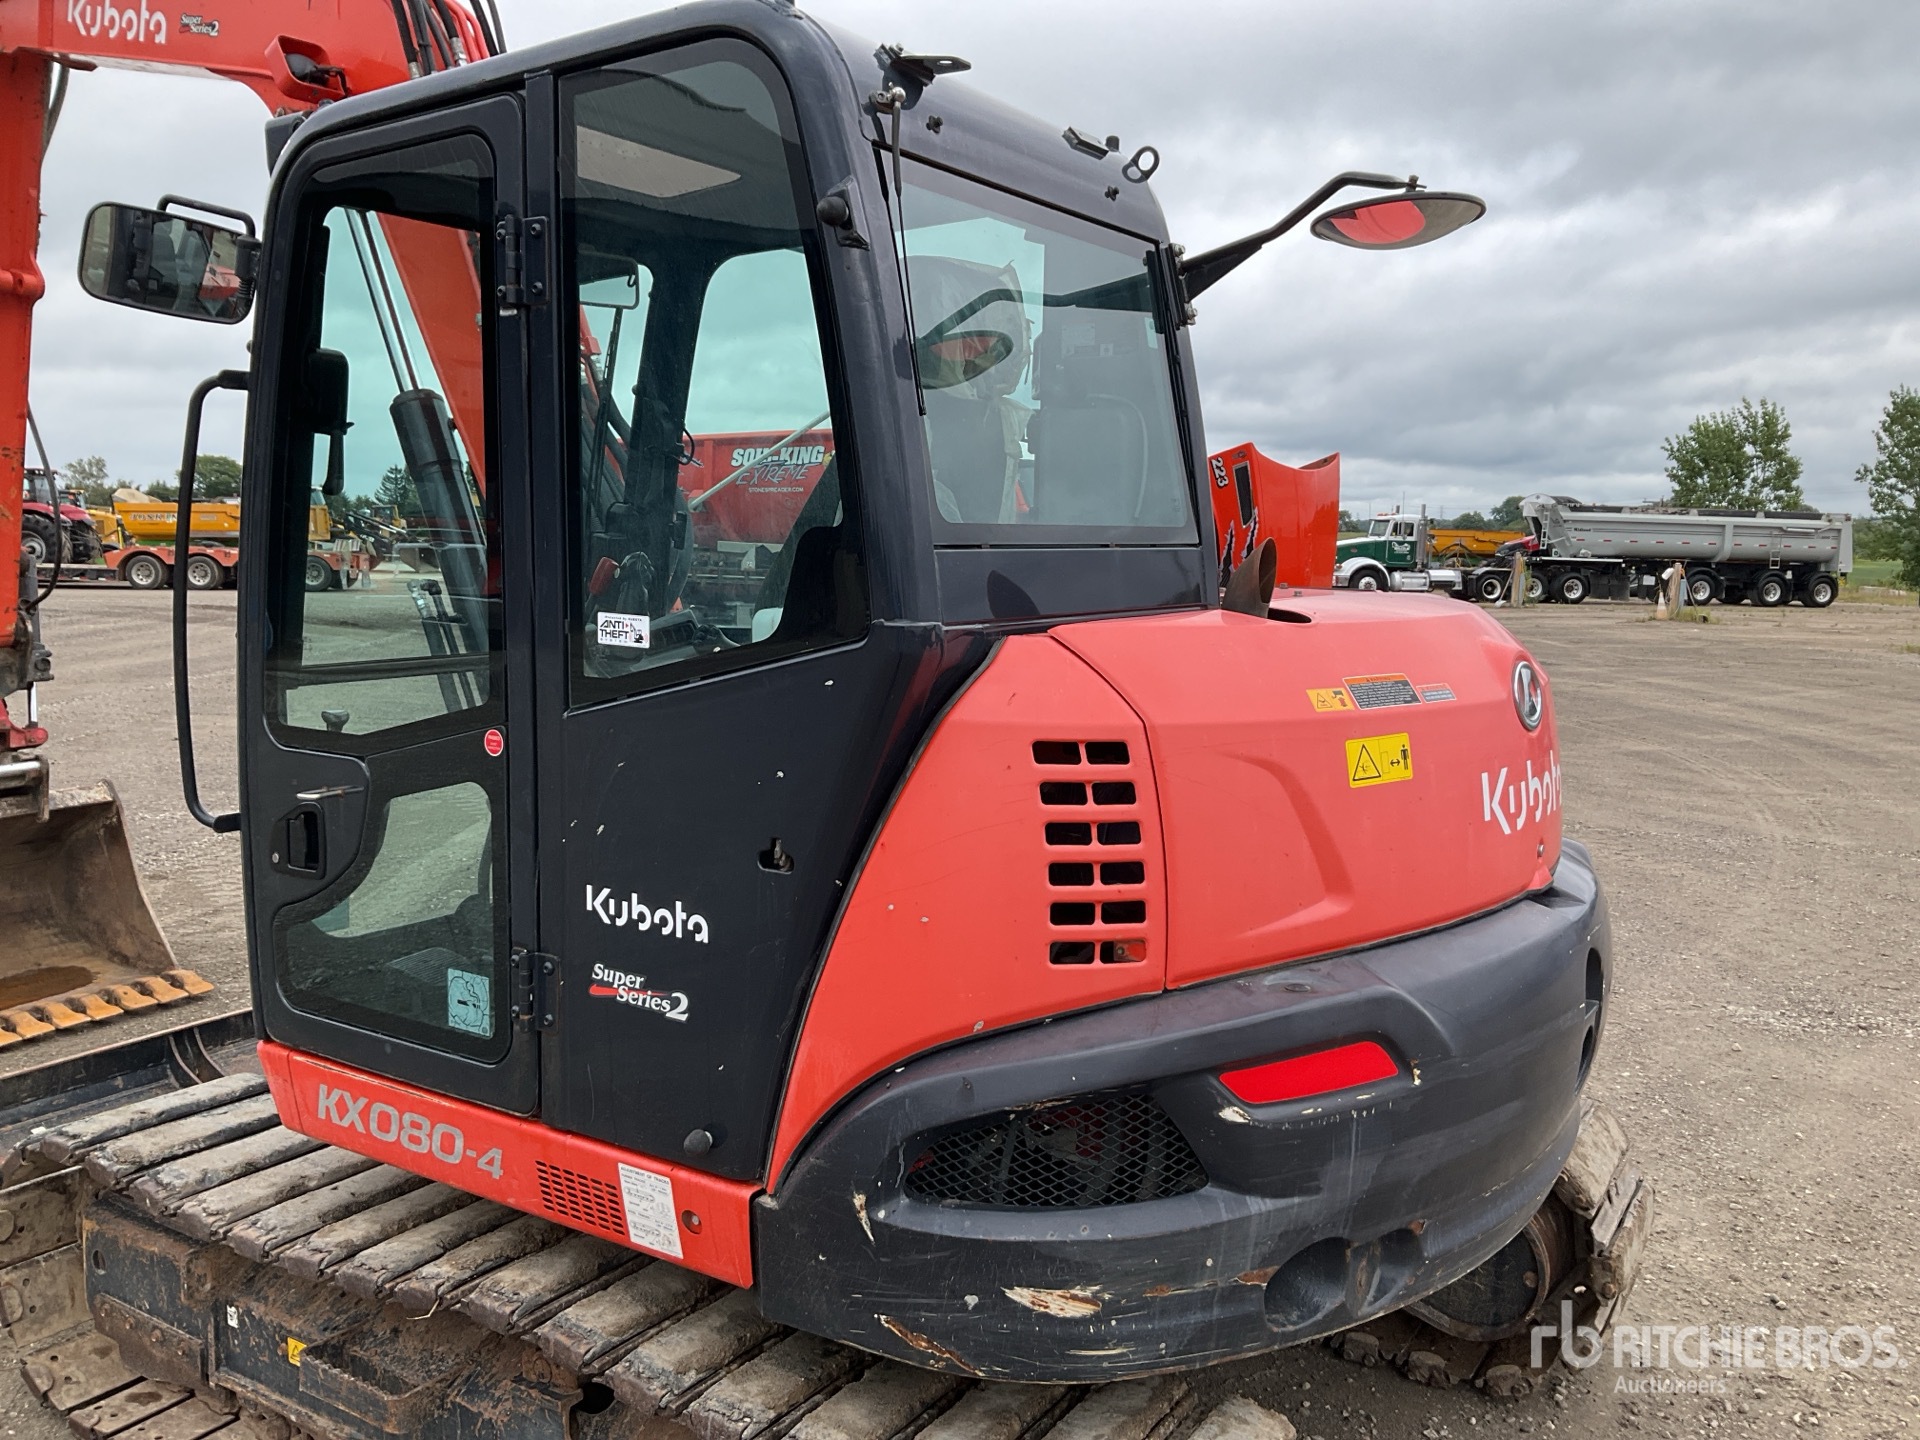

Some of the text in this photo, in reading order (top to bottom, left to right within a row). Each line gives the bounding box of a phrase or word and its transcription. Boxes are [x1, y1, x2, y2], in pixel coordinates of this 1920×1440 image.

[67, 0, 167, 44] Kubota
[181, 13, 202, 25] Super
[736, 463, 820, 485] EXTREME
[1210, 456, 1230, 488] 223
[599, 629, 630, 639] THEFT
[600, 620, 625, 630] ANTI
[586, 884, 709, 944] Kubota
[591, 963, 645, 989] Super
[318, 1084, 504, 1180] KX080-4
